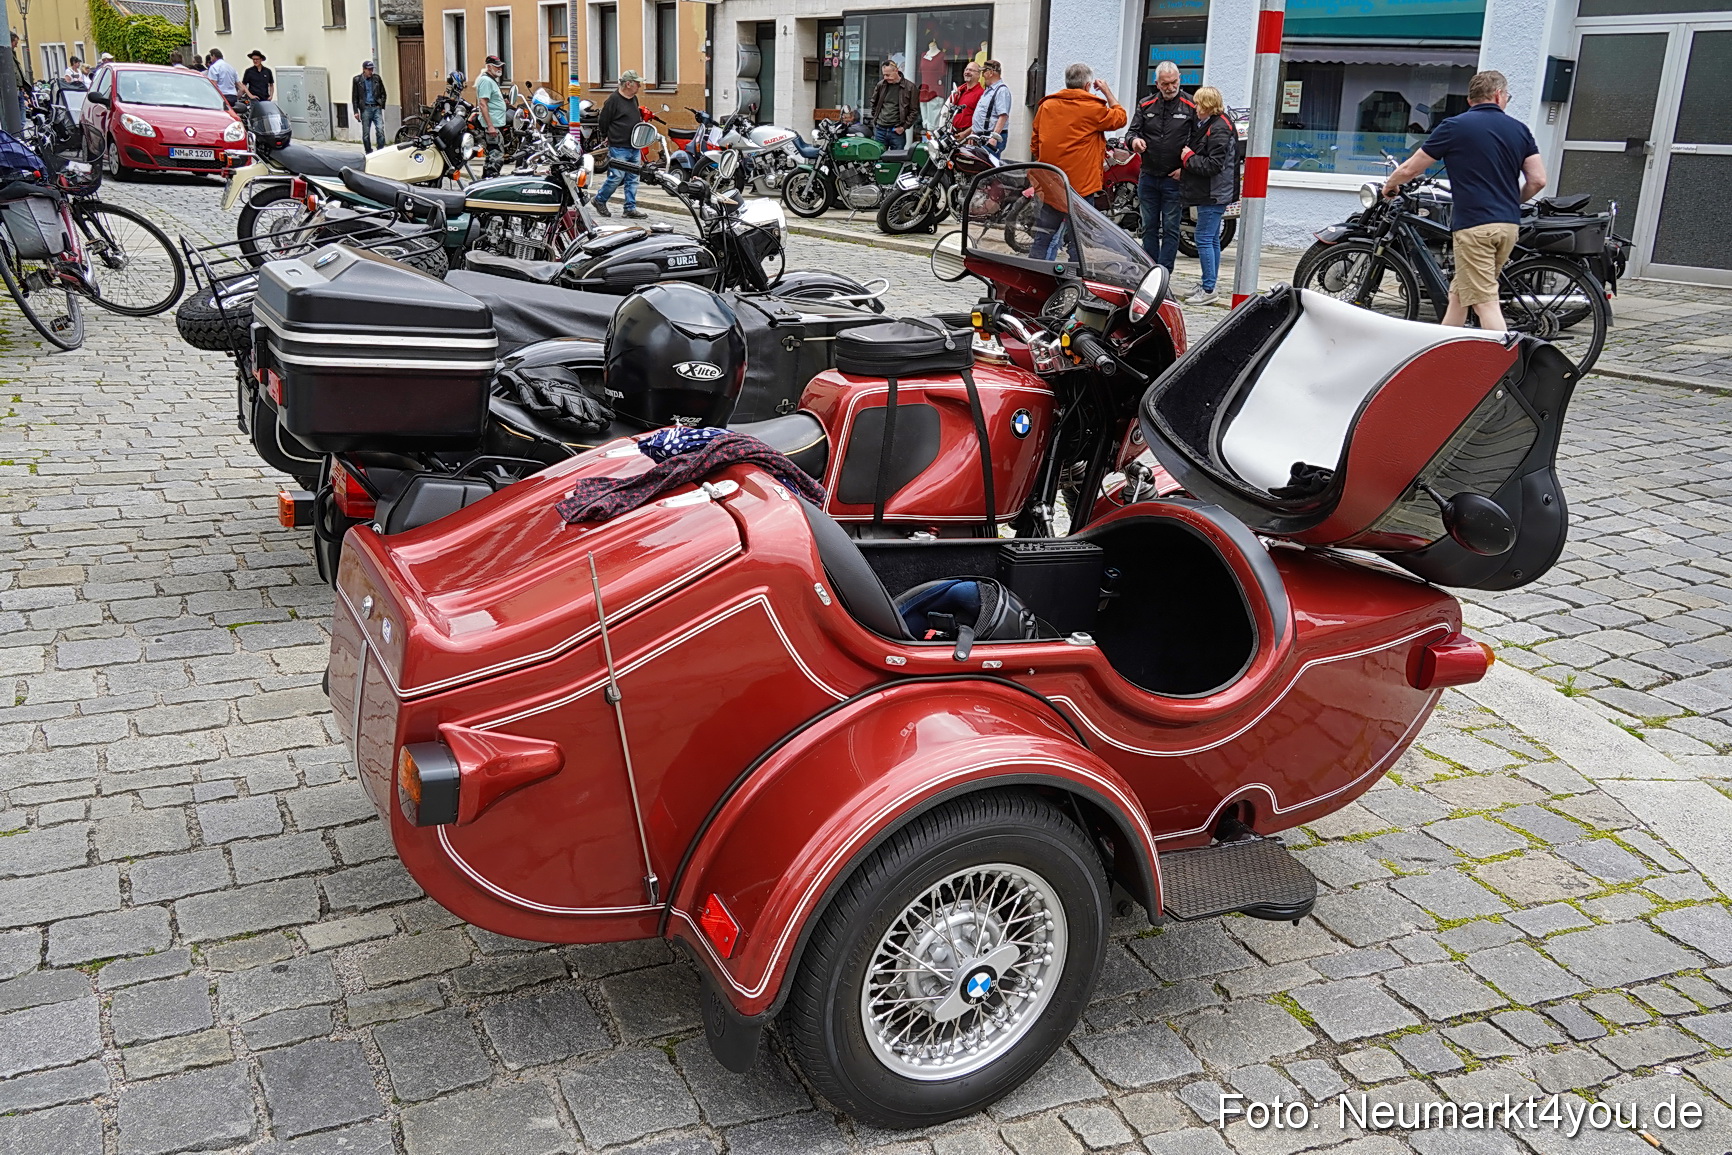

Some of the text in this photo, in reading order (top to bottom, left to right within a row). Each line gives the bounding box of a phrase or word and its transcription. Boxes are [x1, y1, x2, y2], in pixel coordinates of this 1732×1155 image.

[1151, 47, 1202, 64] Reinigung
[763, 134, 788, 145] SUZUKI
[195, 150, 213, 158] 1207
[676, 255, 698, 266] URAL
[683, 363, 717, 377] X-lite
